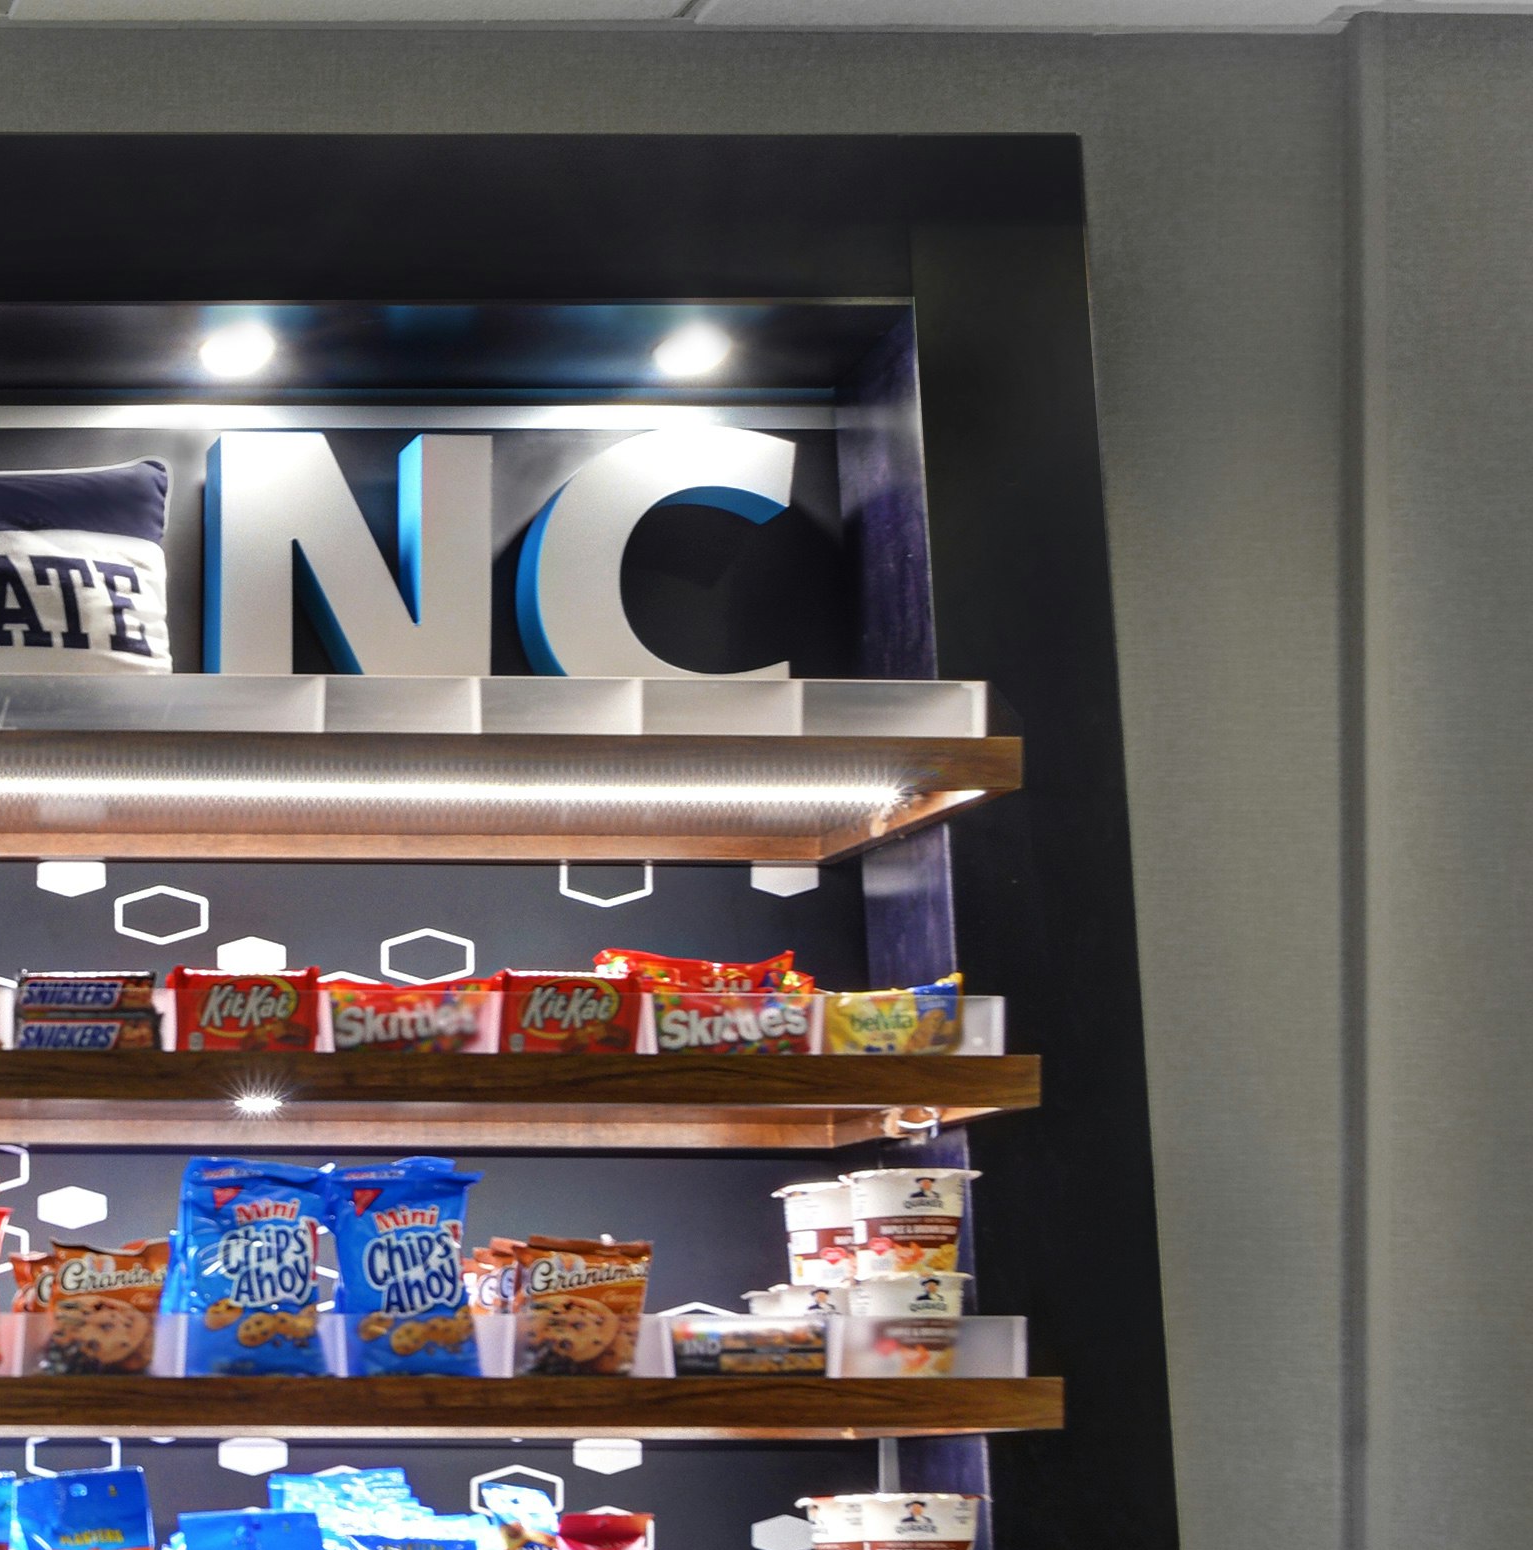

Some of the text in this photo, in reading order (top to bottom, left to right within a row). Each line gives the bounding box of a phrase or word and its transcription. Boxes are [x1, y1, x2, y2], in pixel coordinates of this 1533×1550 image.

[201, 425, 797, 679] NC
[21, 981, 122, 1006] SNICKERS
[21, 1023, 117, 1049] SNICKERS
[659, 1006, 809, 1050] Skittles
[236, 1200, 300, 1225] Mini
[375, 1206, 439, 1232] Mini
[220, 1226, 308, 1275] Chips
[367, 1230, 452, 1288] Chips
[60, 1528, 125, 1546] PLANTERS
